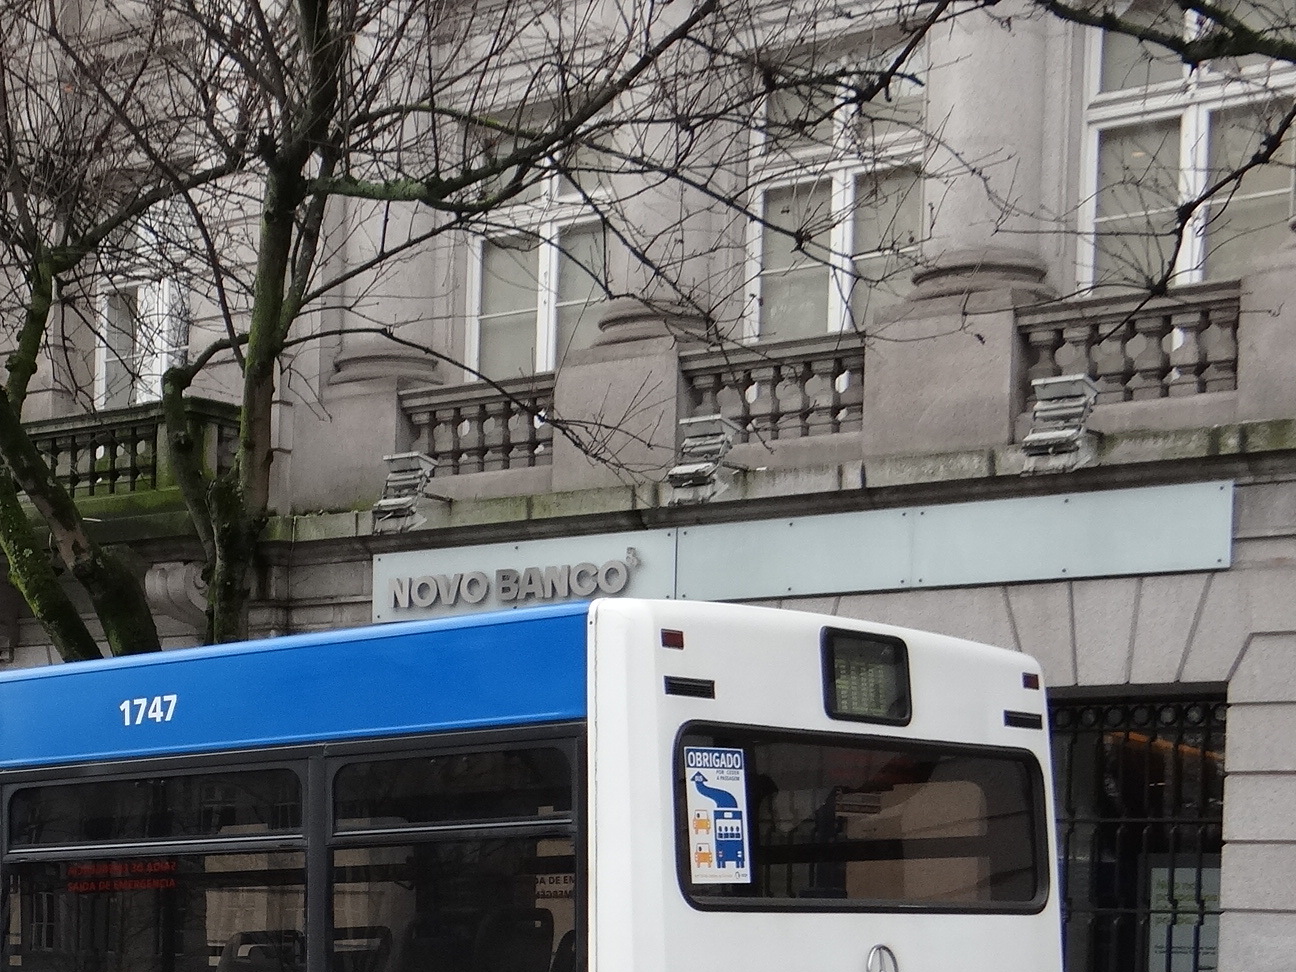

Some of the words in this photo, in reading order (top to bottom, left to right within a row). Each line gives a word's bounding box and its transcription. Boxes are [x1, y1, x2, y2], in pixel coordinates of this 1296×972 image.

[389, 571, 490, 608] NOVO
[495, 560, 629, 601] BANCO
[119, 694, 178, 726] 1747
[688, 752, 741, 768] OBRIGADO
